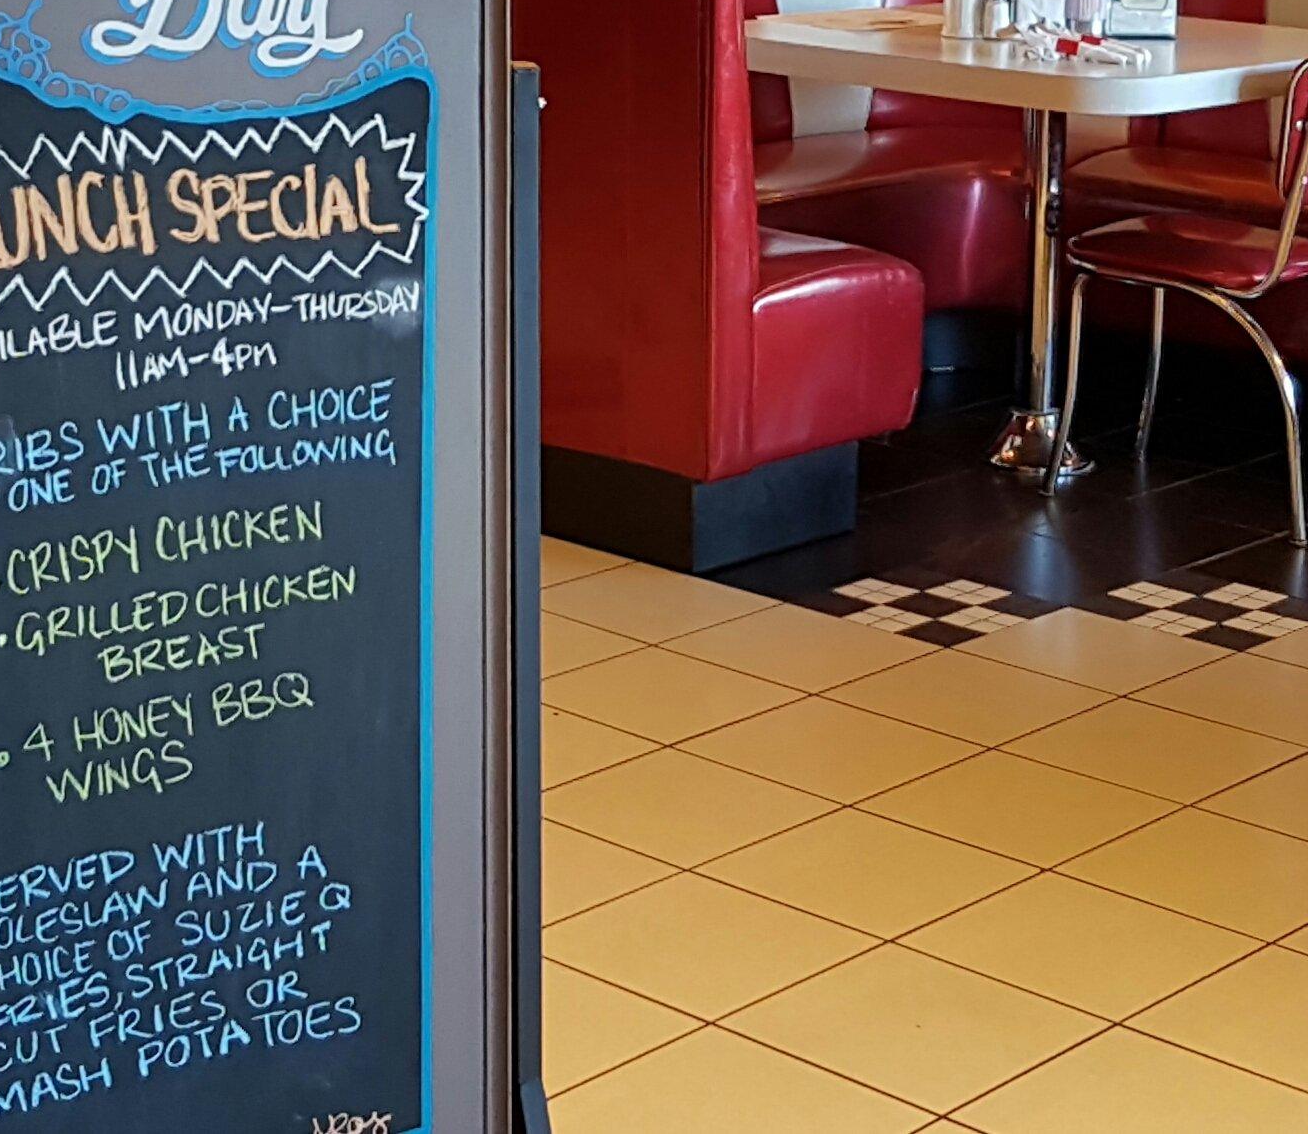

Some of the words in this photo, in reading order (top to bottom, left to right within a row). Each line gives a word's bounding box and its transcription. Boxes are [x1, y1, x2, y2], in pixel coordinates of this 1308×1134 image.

[166, 156, 401, 244] SPECIAL
[96, 400, 211, 455] WITH
[227, 396, 250, 433] A
[267, 377, 395, 429] CHOICE
[7, 470, 76, 513] ONE
[91, 458, 127, 496] OF
[141, 443, 212, 488] THE
[214, 428, 398, 479] FOLLOWING
[6, 525, 140, 595] CRISPY
[155, 500, 324, 562] CHICKEN
[14, 590, 189, 656] GRILLED
[194, 565, 358, 619] CHICKEN
[97, 623, 267, 683] BREAST
[22, 722, 56, 761] 4
[73, 692, 195, 753] HONEY
[210, 672, 315, 728] BBQ
[45, 738, 195, 803] WINGS
[151, 820, 265, 876] WITH
[185, 861, 278, 902] AND
[297, 844, 328, 880] A
[107, 922, 151, 962] OF
[174, 890, 307, 947] SUZIE
[318, 880, 352, 910] Q
[124, 920, 333, 997] STRAIGHT
[89, 989, 227, 1050] FRIES
[245, 969, 309, 1009] OR
[137, 996, 362, 1079] POTATOES
